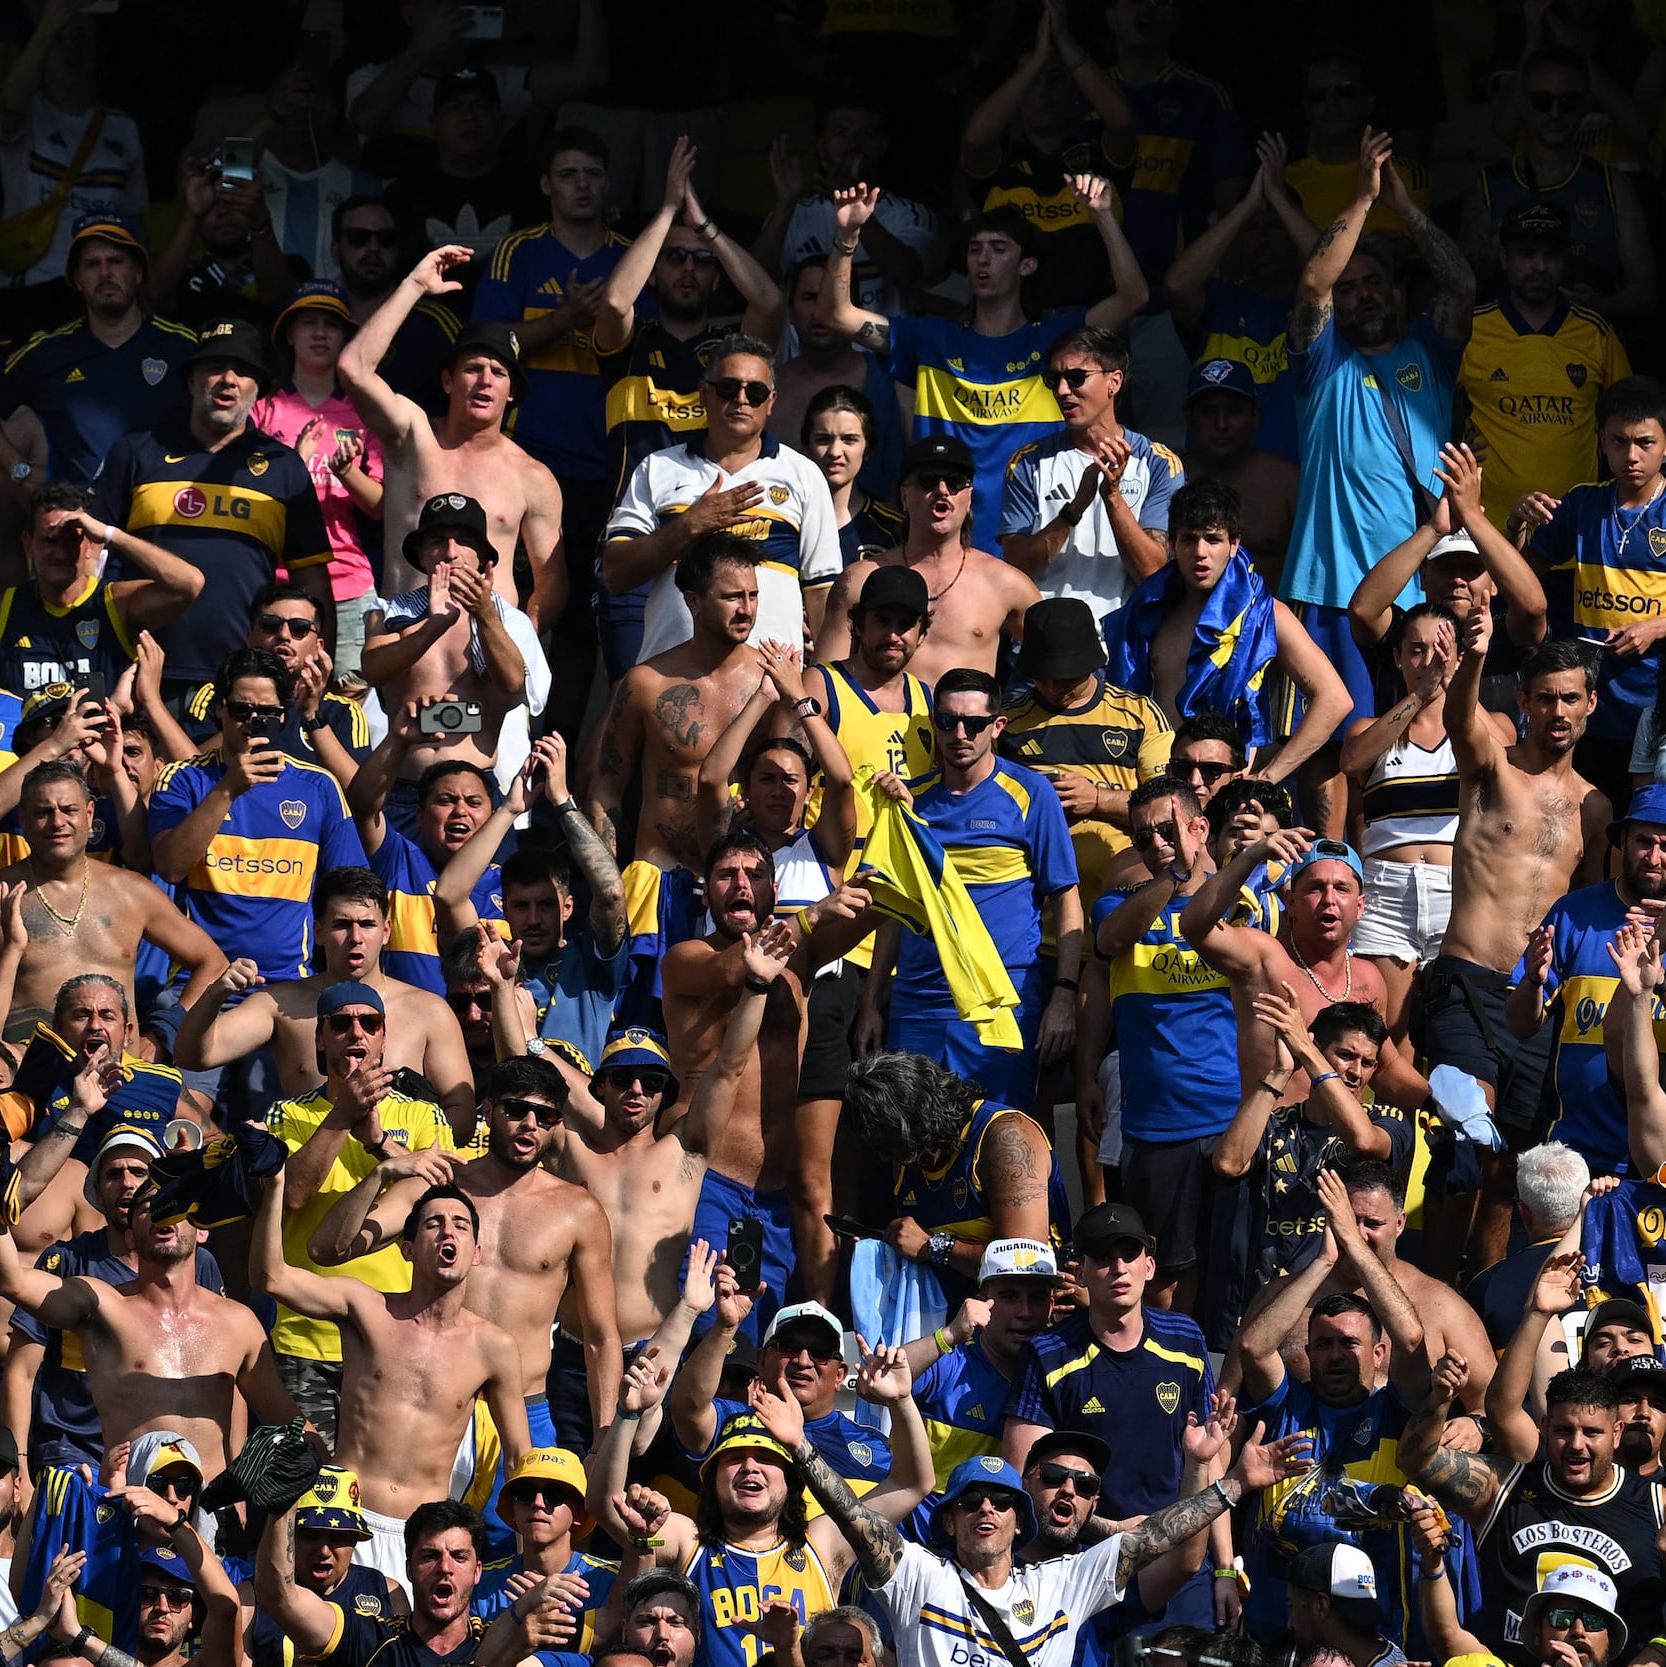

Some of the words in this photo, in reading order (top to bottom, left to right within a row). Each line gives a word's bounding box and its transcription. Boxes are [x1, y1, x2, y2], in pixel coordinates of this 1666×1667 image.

[952, 387, 1021, 410] QATAR
[1499, 396, 1574, 416] QATAR
[969, 403, 1021, 419] AIRWAYS
[1520, 413, 1574, 426] AIRWAYS
[214, 496, 251, 519] LG
[1105, 736, 1126, 746] CABJ
[886, 748, 907, 773] 12
[205, 846, 304, 876] betsson
[1169, 971, 1222, 986] AIRWAYS
[992, 1242, 1038, 1255] JUGADOR
[313, 1483, 337, 1493] CABJ
[1518, 1527, 1547, 1550] LOS
[1551, 1522, 1628, 1571] BOSTEROS
[1358, 1574, 1375, 1584] BOCA
